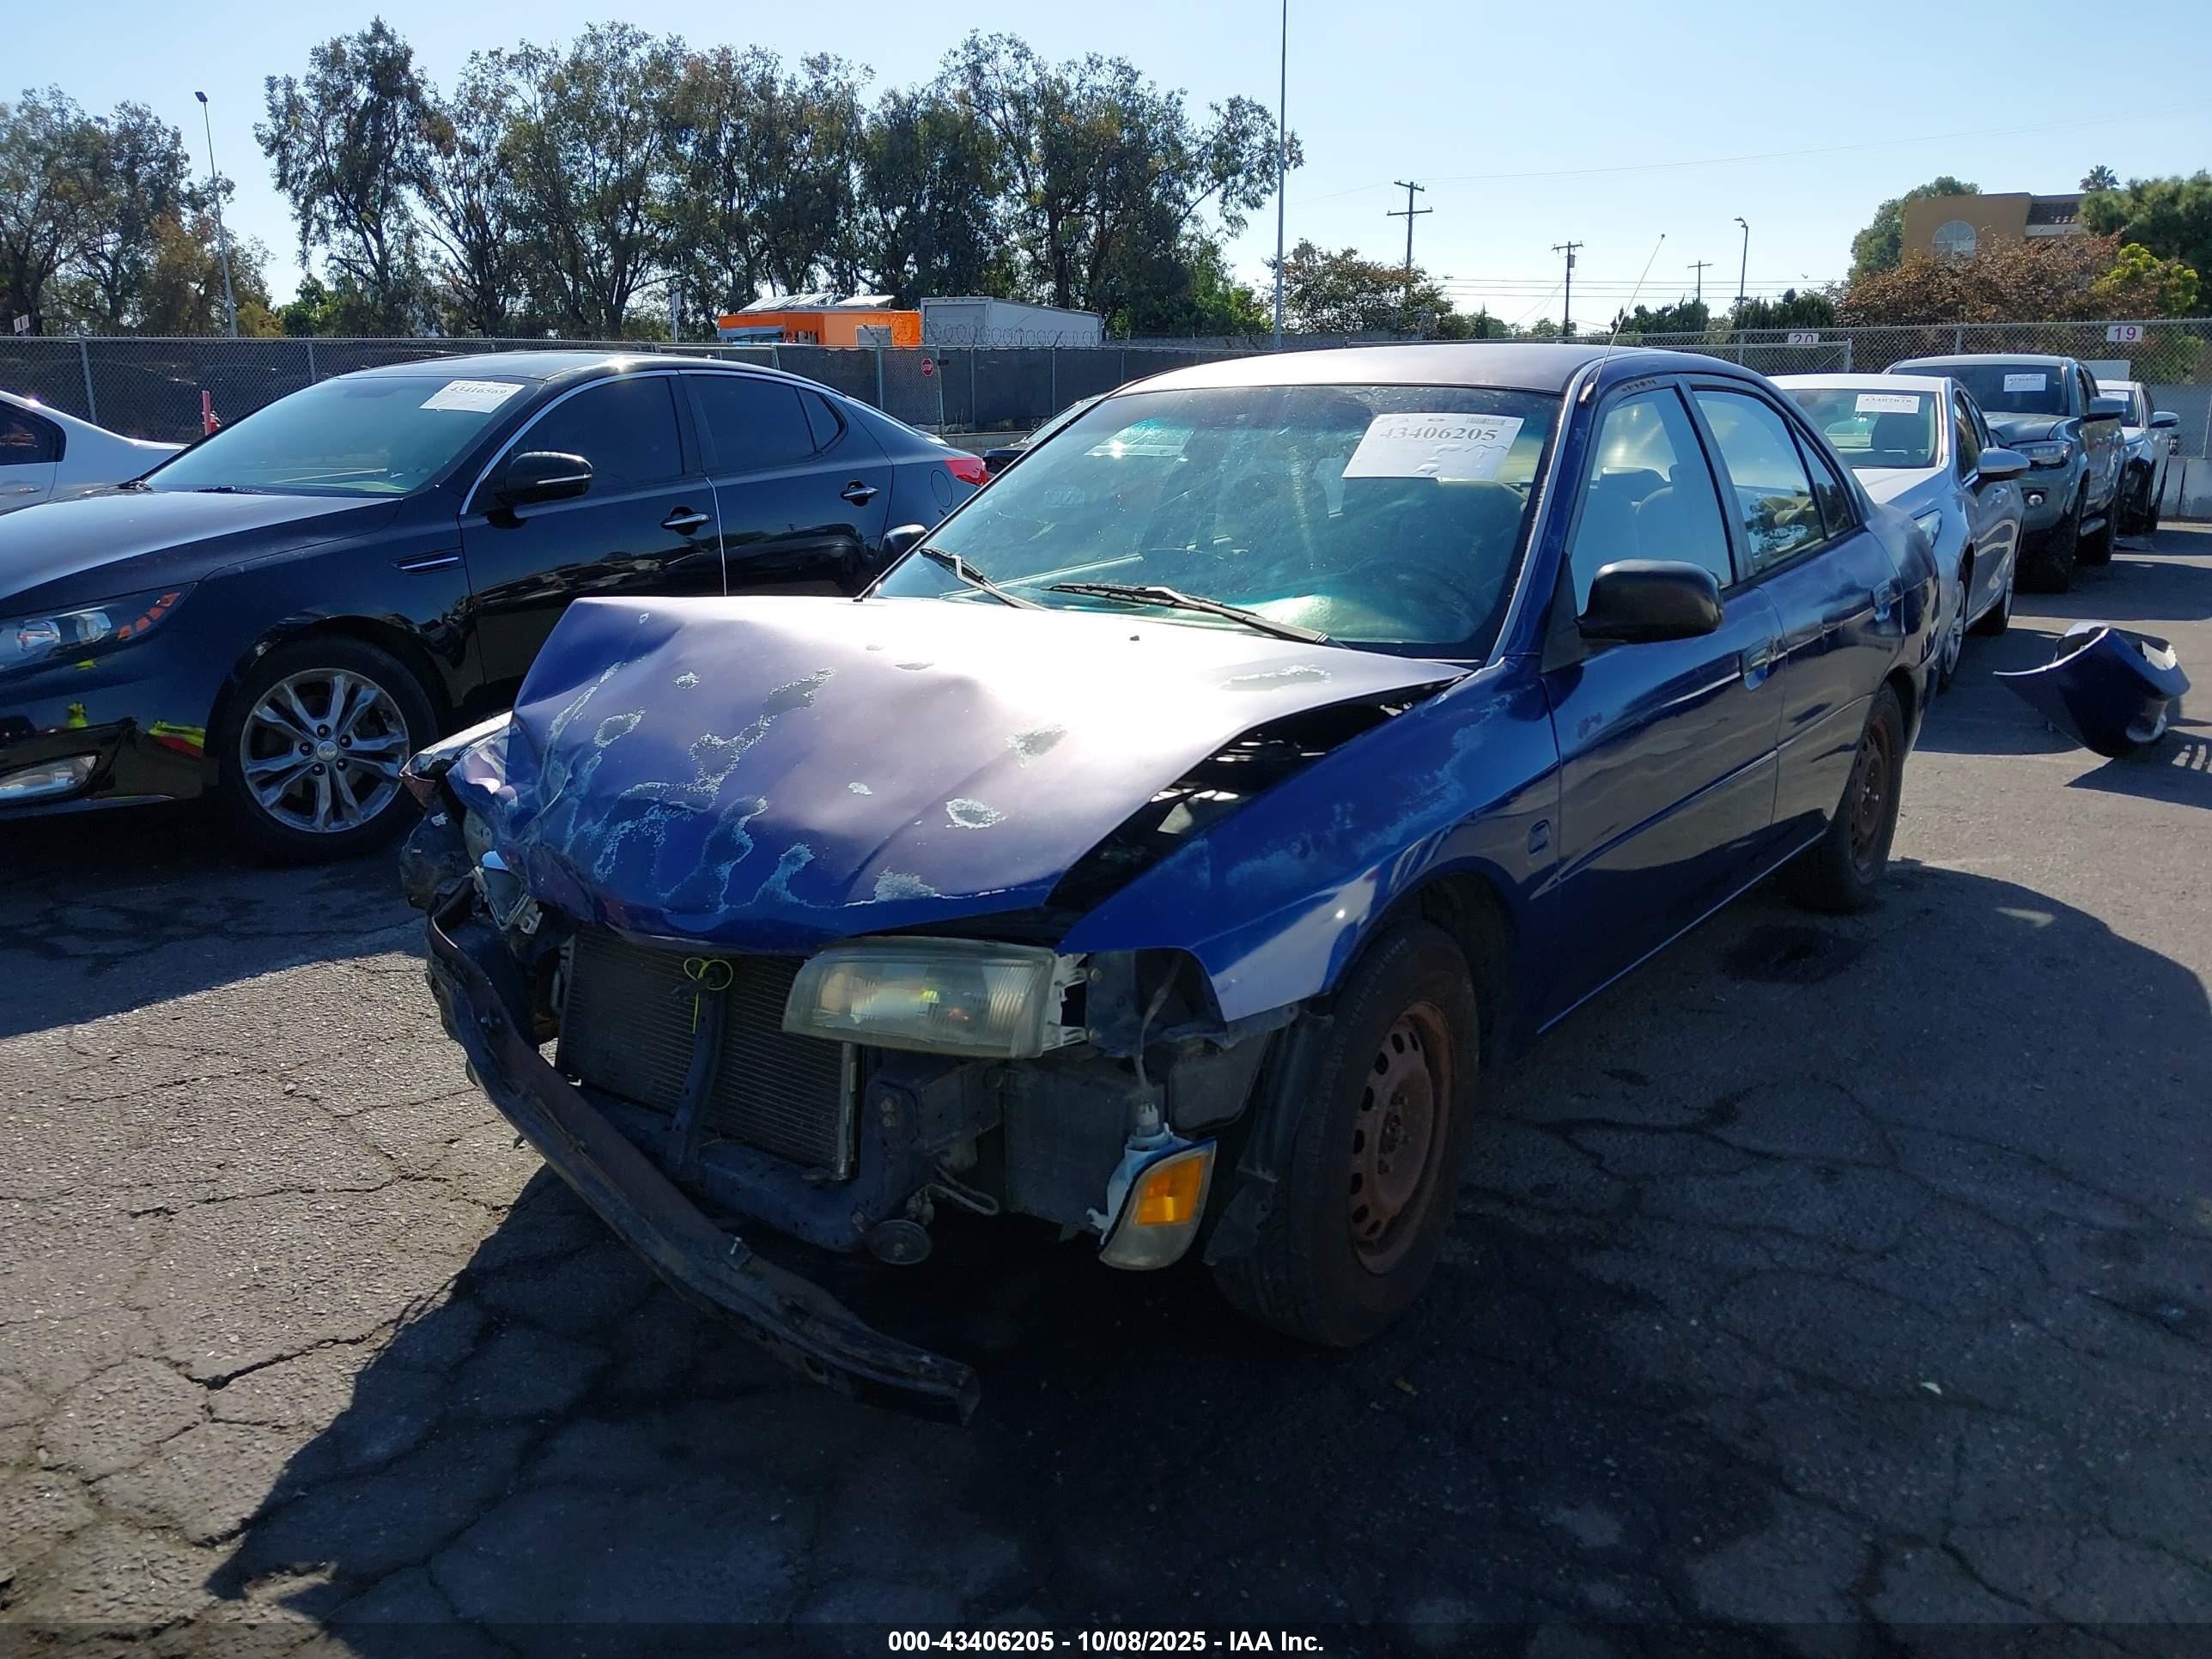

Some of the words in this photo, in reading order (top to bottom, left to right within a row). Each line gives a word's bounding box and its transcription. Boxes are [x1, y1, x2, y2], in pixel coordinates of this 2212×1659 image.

[1794, 333, 1814, 343] 20
[2114, 326, 2136, 340] 19
[1380, 427, 1498, 441] 43406205
